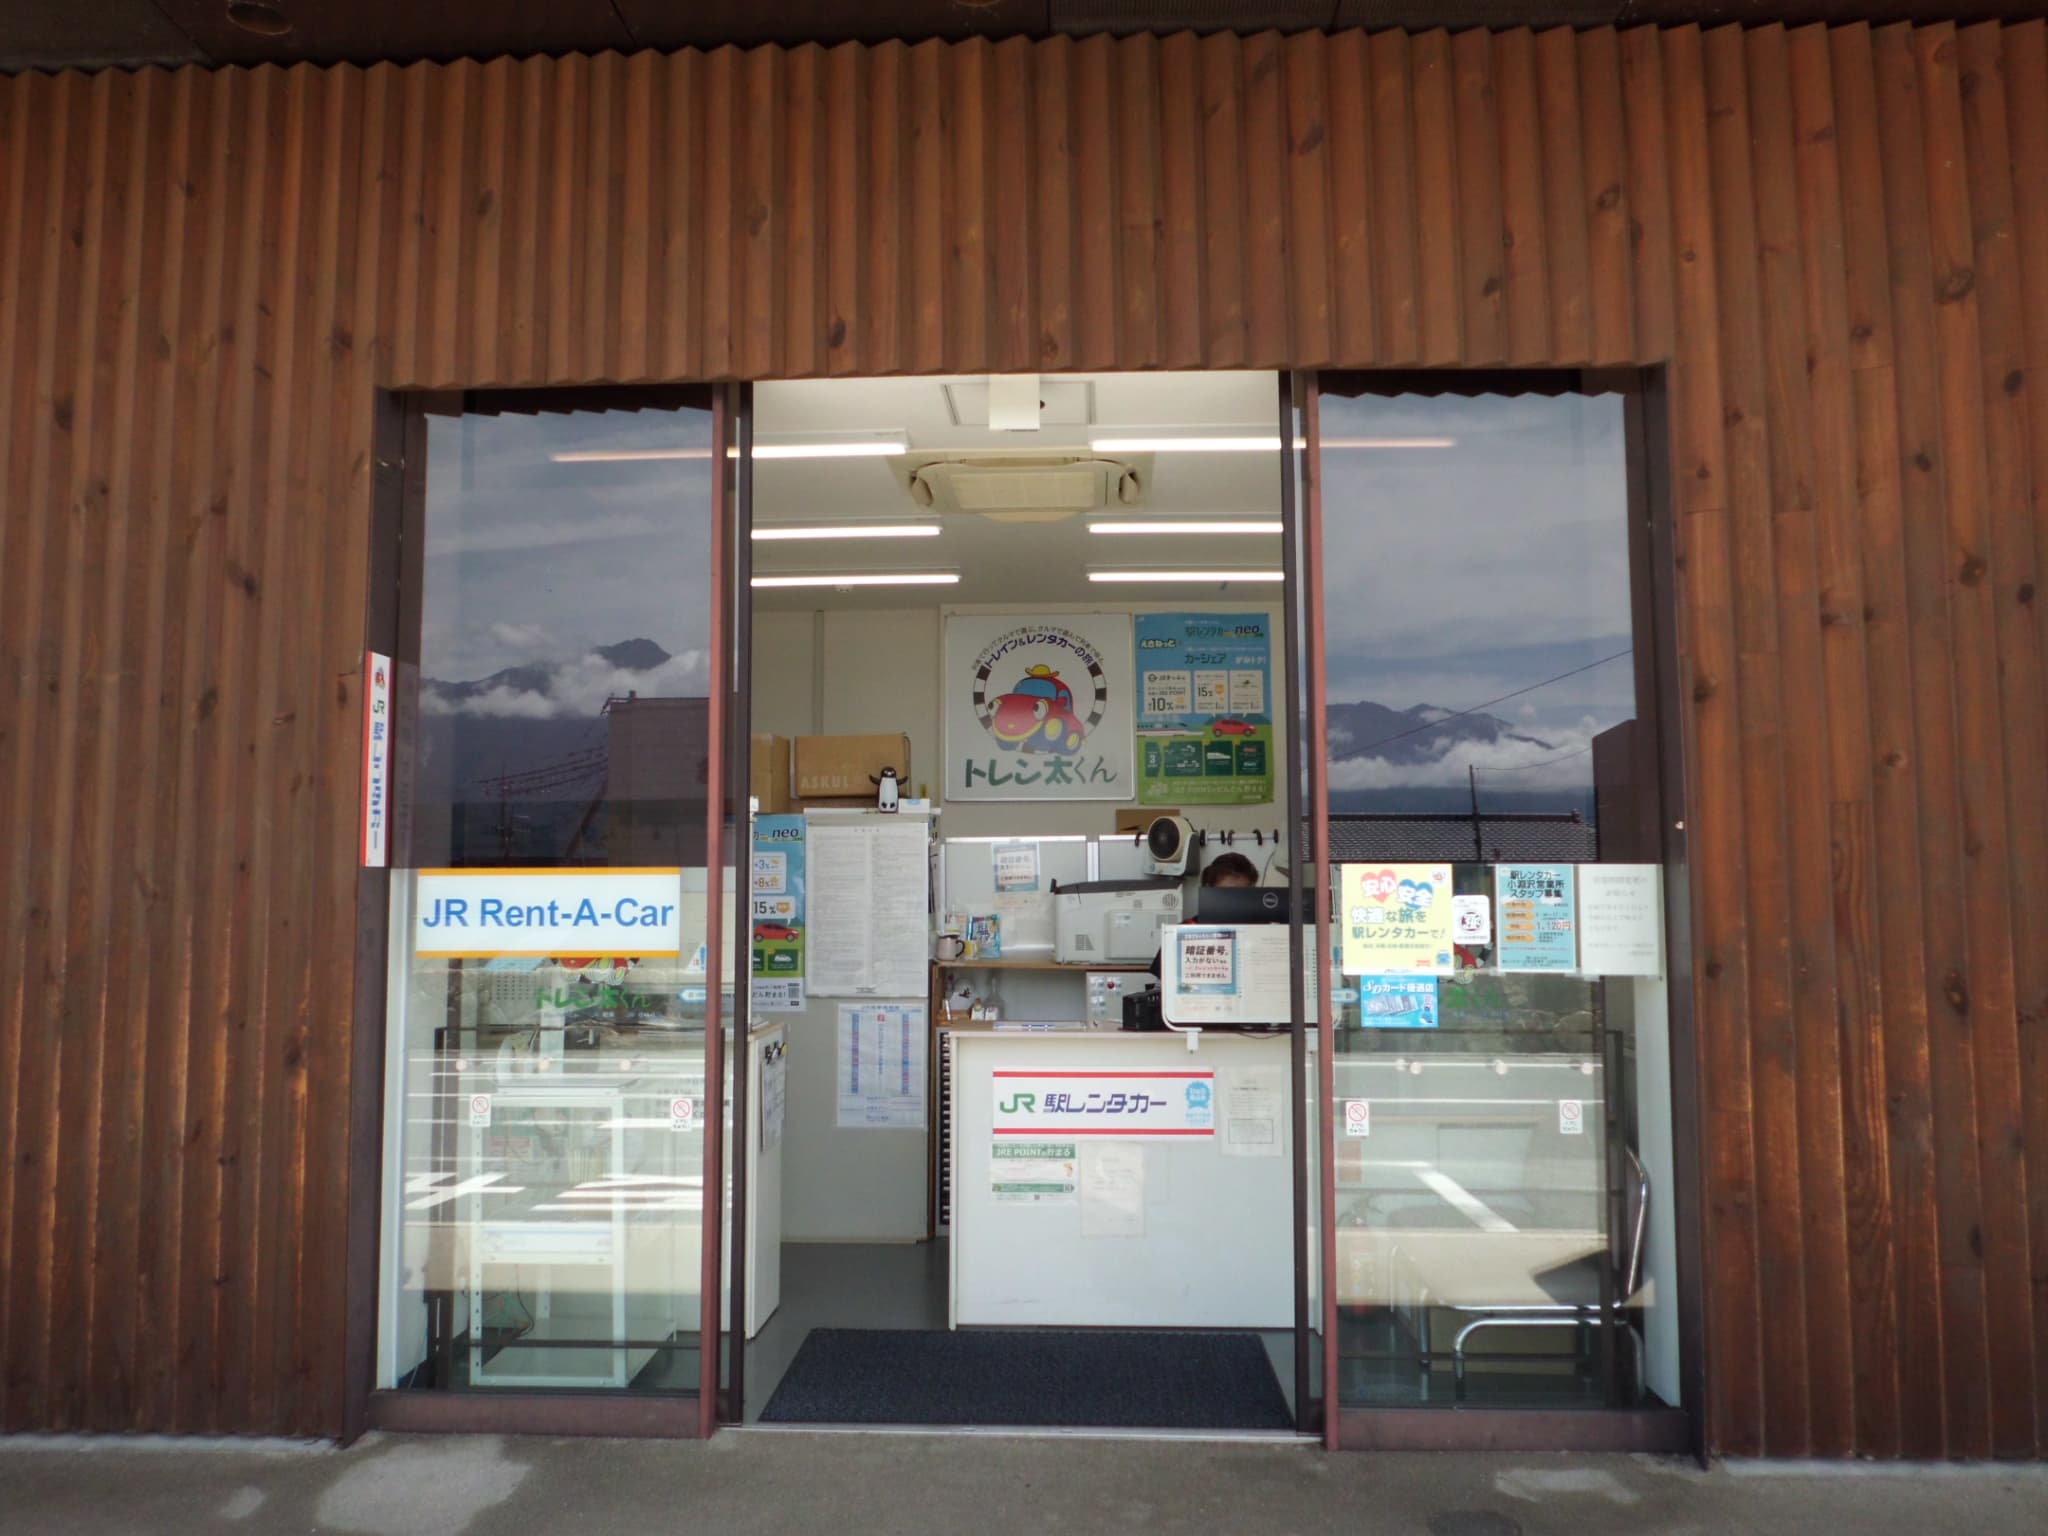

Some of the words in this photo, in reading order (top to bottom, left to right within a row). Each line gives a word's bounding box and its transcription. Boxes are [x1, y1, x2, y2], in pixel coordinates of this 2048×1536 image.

[1184, 653, 1226, 664] カーシェア
[965, 756, 1118, 788] トレン太くん
[800, 776, 849, 789] ASKUL
[772, 828, 799, 838] neo
[1510, 870, 1561, 880] 駅レンタカー
[1361, 876, 1396, 897] 安心
[1510, 889, 1563, 899] スタッフ募集
[1397, 884, 1432, 907] 安全
[423, 899, 469, 928] JR
[480, 898, 675, 928] Rent-A-Car
[999, 1093, 1036, 1114] JR
[1043, 1093, 1168, 1114] 駅レンタカー
